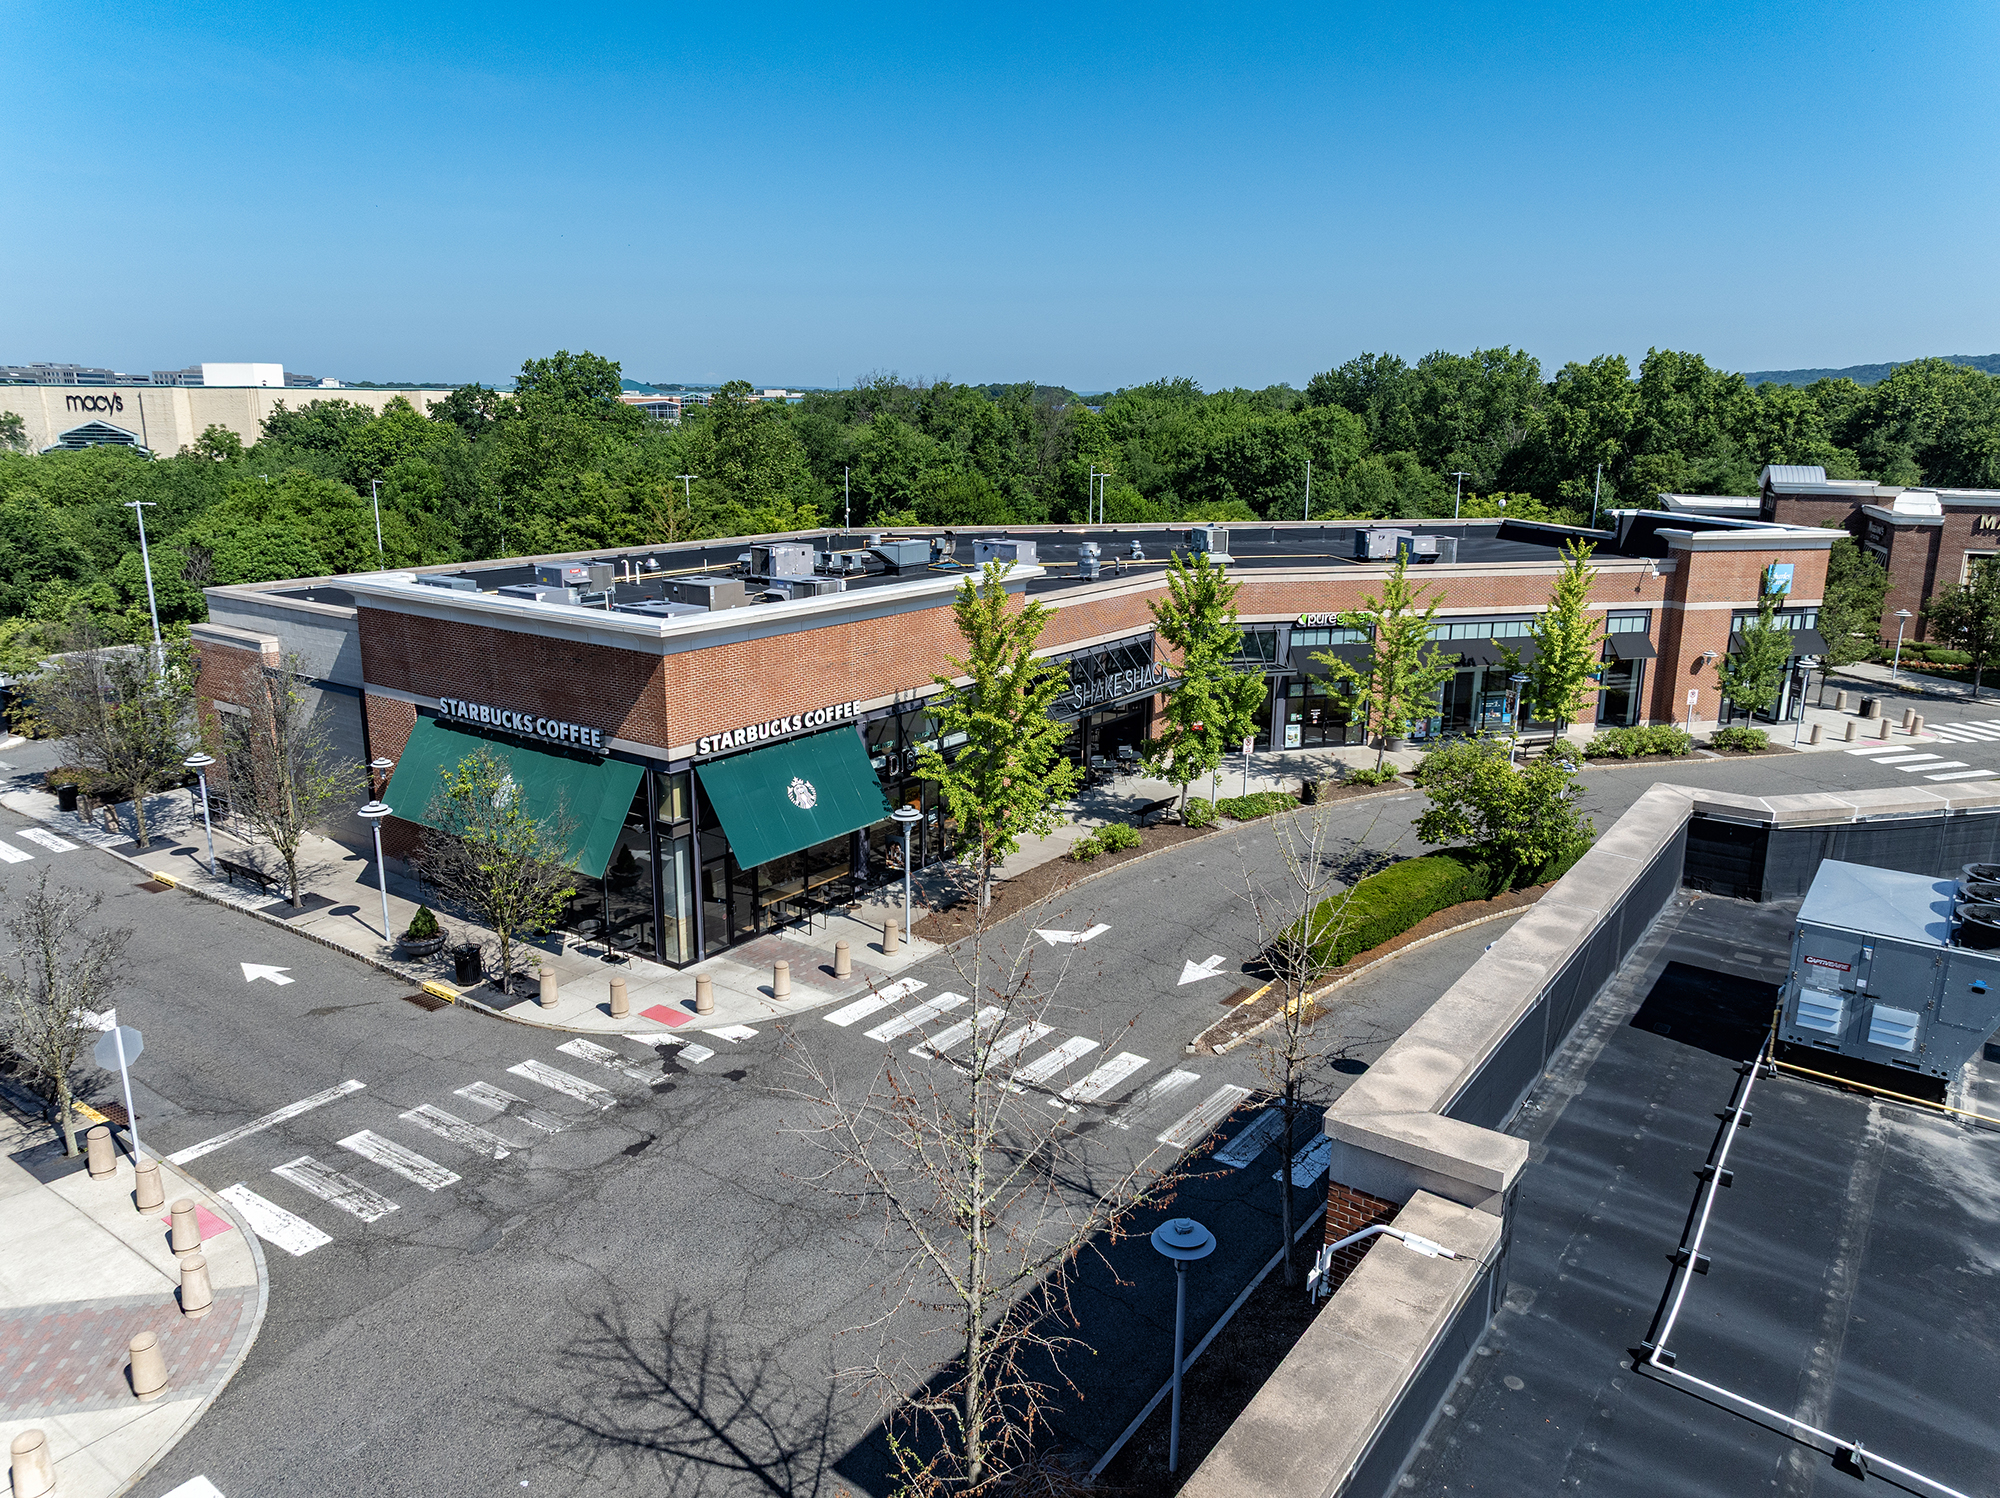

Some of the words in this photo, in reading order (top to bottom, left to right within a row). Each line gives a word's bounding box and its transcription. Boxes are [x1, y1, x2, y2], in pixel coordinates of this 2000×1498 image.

[66, 391, 124, 417] macy's
[1979, 515, 2000, 530] M
[1072, 672, 1123, 709] SHAKE
[1124, 659, 1171, 693] SHACK
[439, 697, 534, 733] STARBUCKS
[536, 718, 602, 748] COFFEE
[698, 715, 802, 755] STARBUCKS
[804, 700, 862, 728] COFFEE
[889, 750, 916, 777] DIG
[1806, 956, 1849, 971] CAPTIVEAIRE
